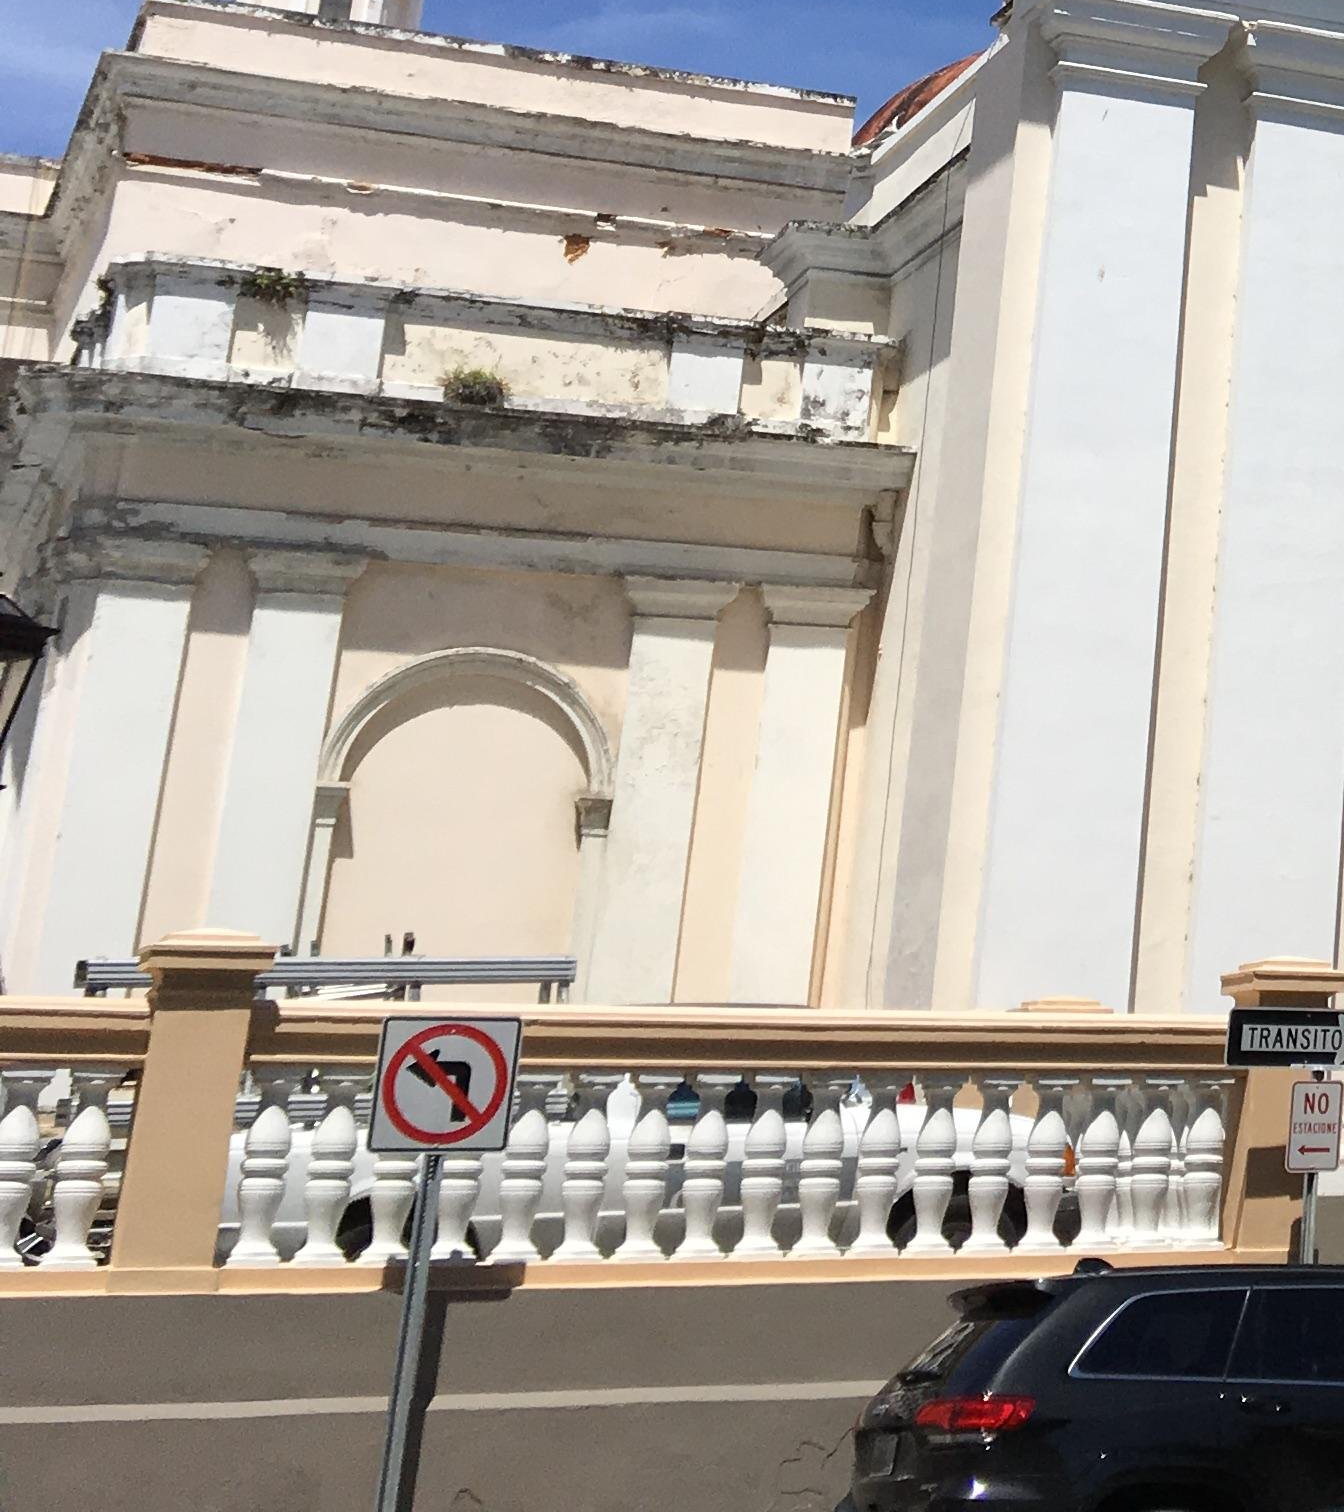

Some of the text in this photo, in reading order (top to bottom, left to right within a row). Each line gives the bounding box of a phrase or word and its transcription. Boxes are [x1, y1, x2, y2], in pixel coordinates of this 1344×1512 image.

[1248, 1027, 1343, 1051] TRANSITO
[1303, 1092, 1329, 1115] NO
[1293, 1122, 1338, 1135] ESTACIONE
